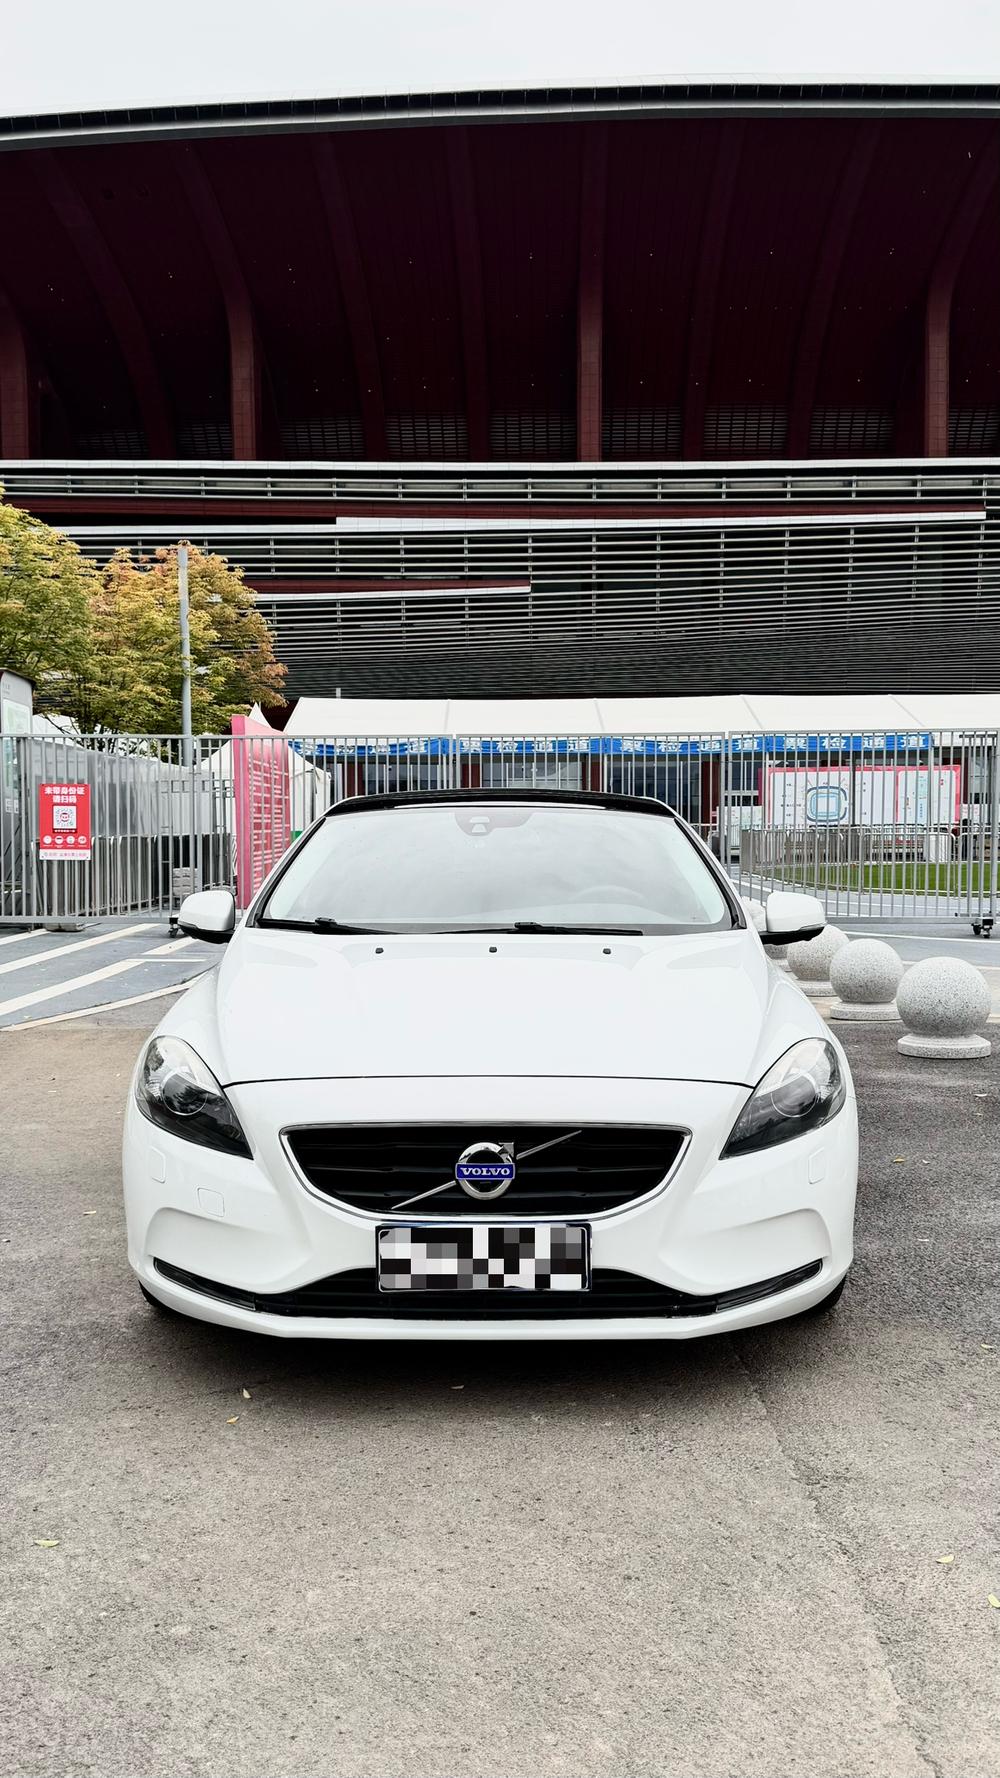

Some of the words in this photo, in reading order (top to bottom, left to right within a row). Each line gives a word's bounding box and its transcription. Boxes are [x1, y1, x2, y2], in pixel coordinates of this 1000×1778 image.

[44, 786, 85, 795] 未带身份证
[52, 795, 77, 803] 请扫码
[460, 1167, 511, 1176] VOLVO
